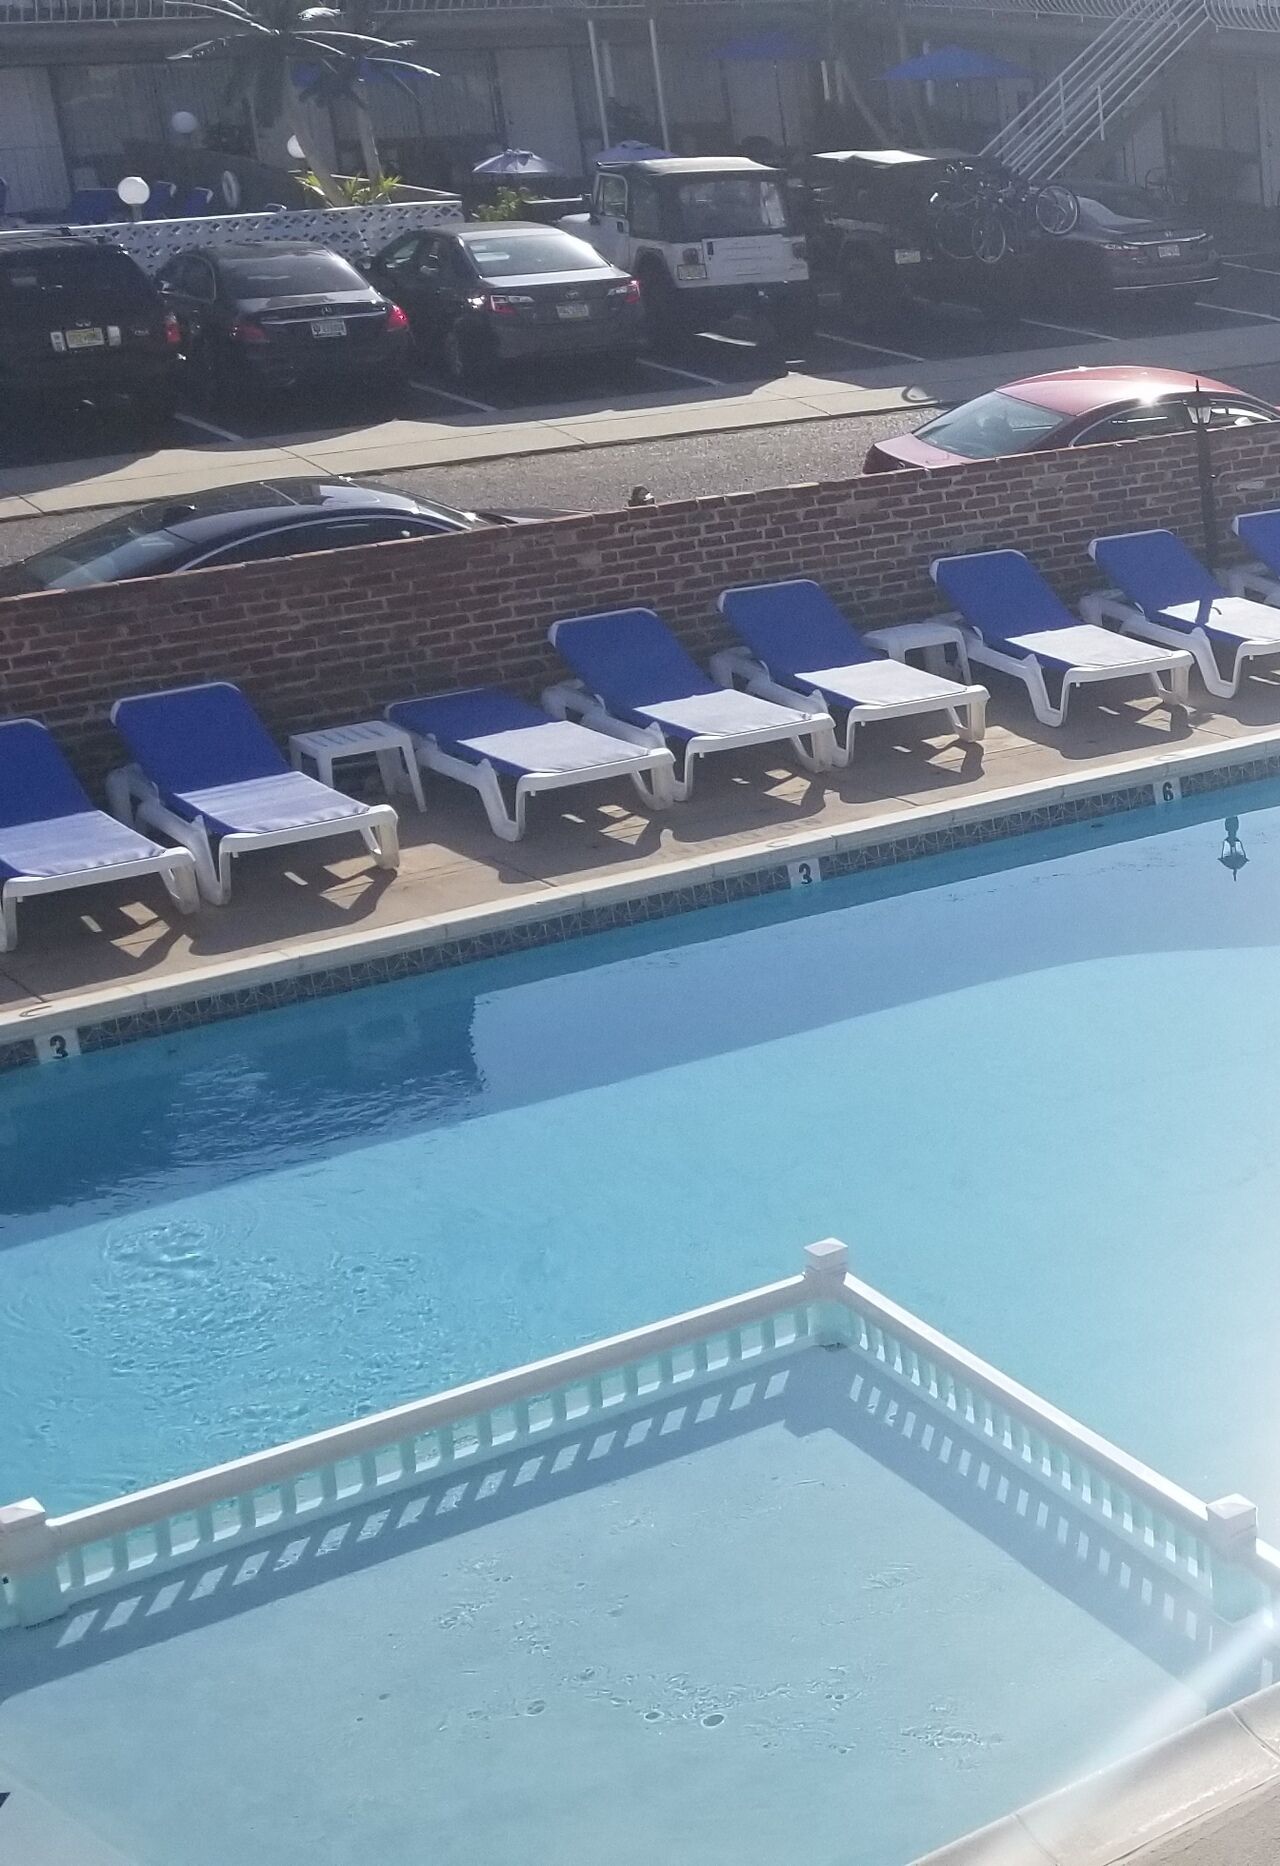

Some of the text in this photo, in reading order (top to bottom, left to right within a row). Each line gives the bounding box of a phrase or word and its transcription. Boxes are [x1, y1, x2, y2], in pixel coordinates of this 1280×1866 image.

[1162, 781, 1174, 802] 6
[798, 862, 813, 885] 3
[49, 1035, 69, 1060] 3
